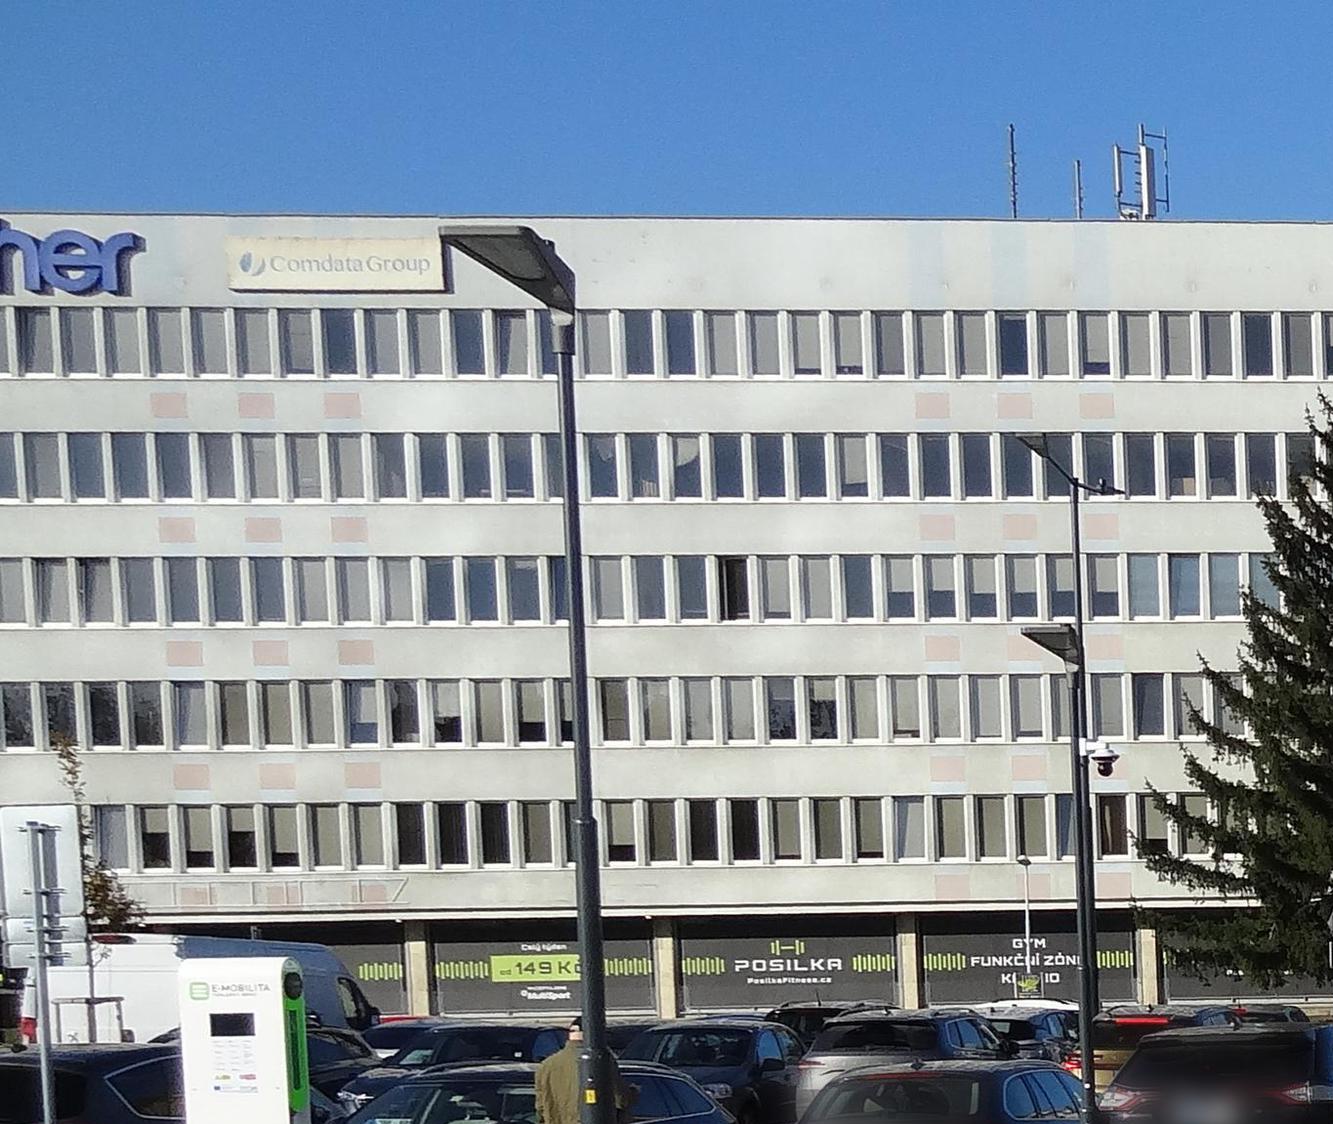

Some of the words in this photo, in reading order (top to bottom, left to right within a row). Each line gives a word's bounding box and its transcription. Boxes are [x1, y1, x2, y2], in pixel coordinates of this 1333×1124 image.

[270, 254, 363, 273] Comdata
[366, 255, 430, 275] Group
[1012, 938, 1046, 949] GYM
[734, 958, 843, 973] POSILKA
[970, 952, 1040, 967] FUNKČNÍ
[1043, 952, 1080, 966] ZÓN
[516, 961, 552, 975] 149
